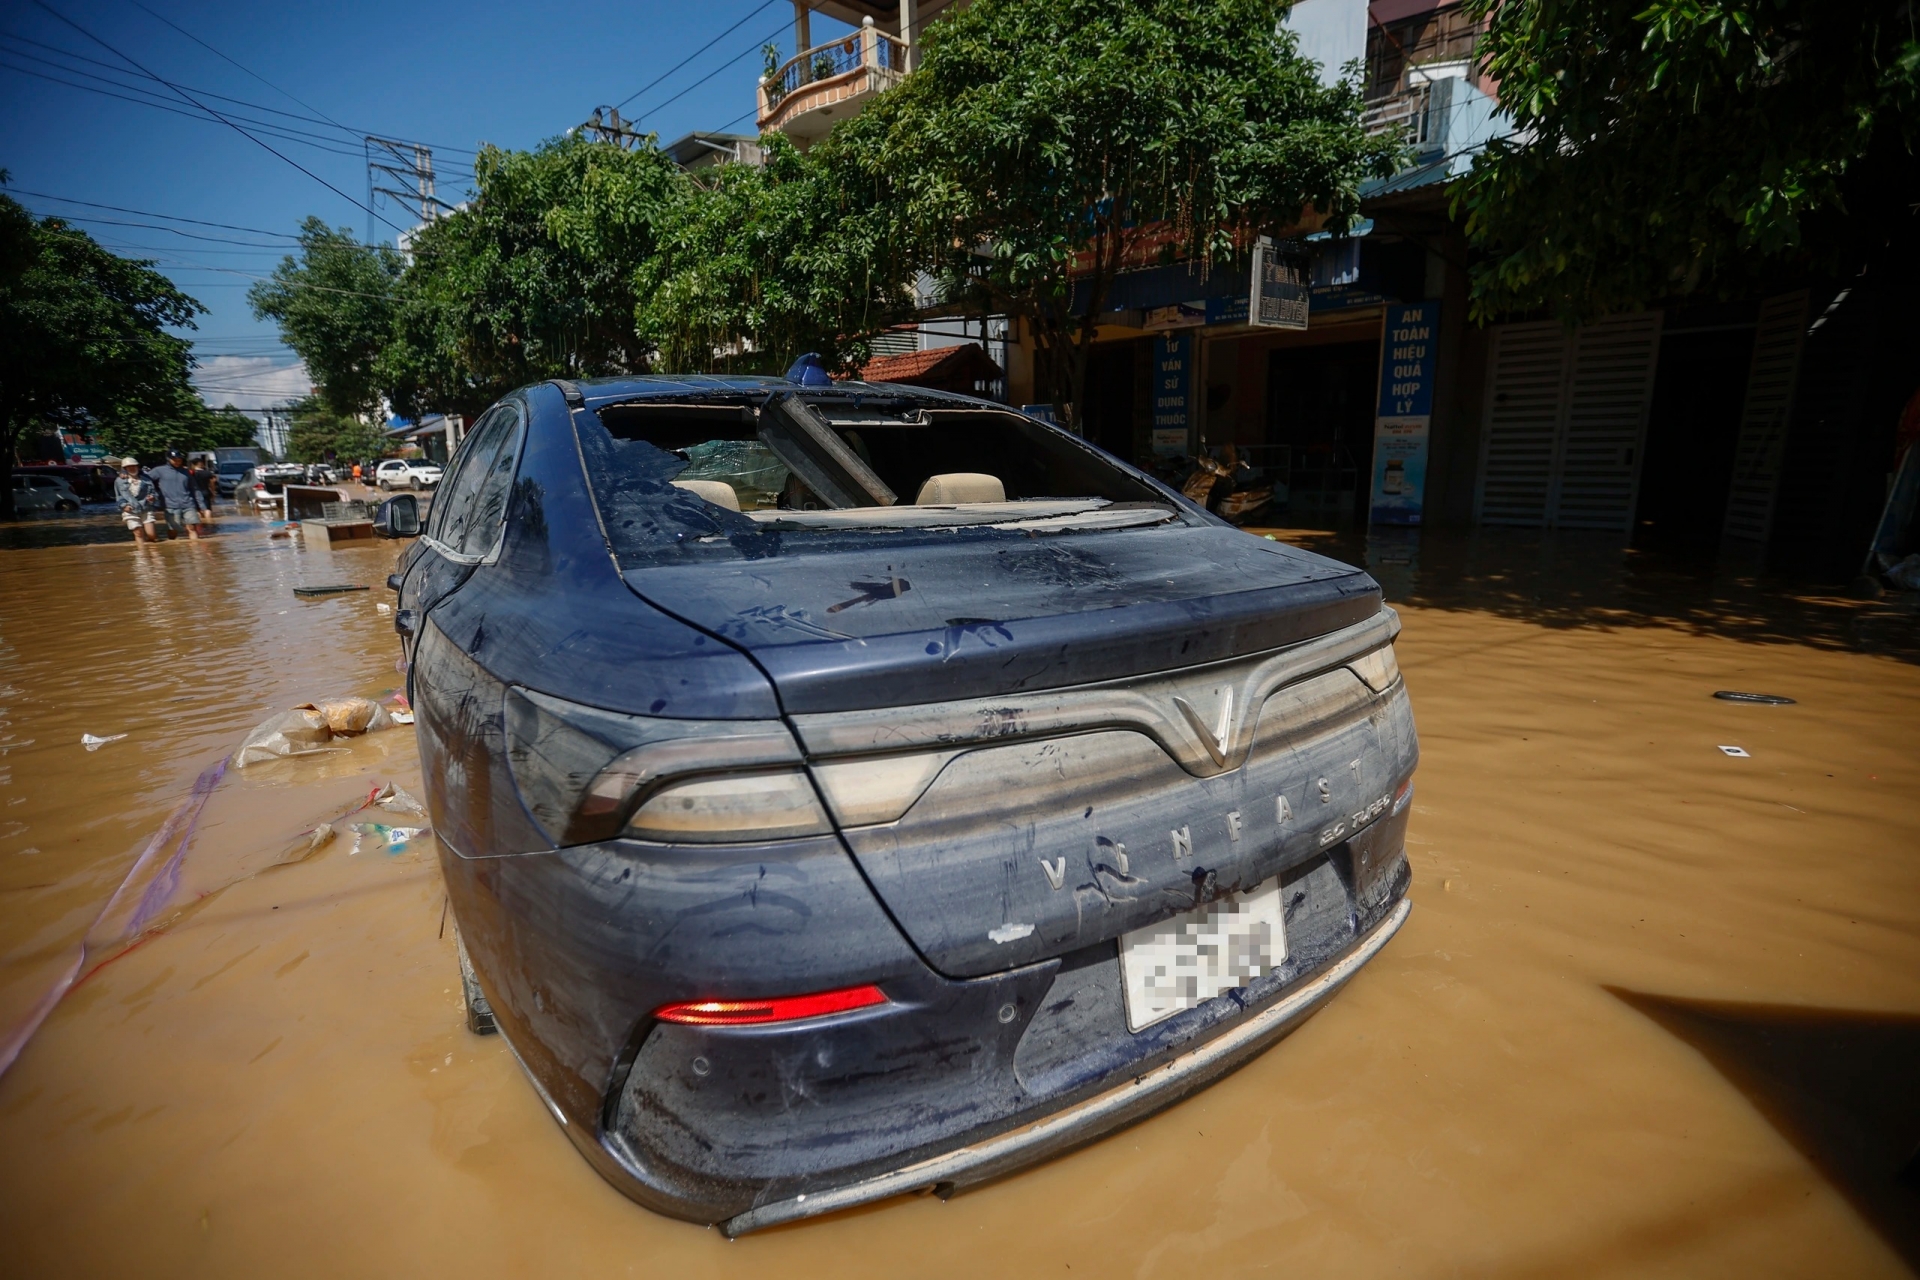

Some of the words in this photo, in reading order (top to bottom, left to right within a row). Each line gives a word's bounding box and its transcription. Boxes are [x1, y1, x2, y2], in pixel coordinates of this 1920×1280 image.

[1401, 309, 1423, 323] AN
[1392, 325, 1430, 343] TOÀN
[1166, 340, 1179, 353] TƯ
[1393, 344, 1426, 362] HIỆU
[1161, 356, 1182, 372] VẤN
[1393, 360, 1422, 379] QUẢ
[1164, 374, 1179, 389] SỬ
[1391, 382, 1421, 399] HỢP
[1158, 396, 1184, 410] DỤNG
[1155, 410, 1186, 425] THUỐC
[1040, 757, 1364, 891] VINFAST
